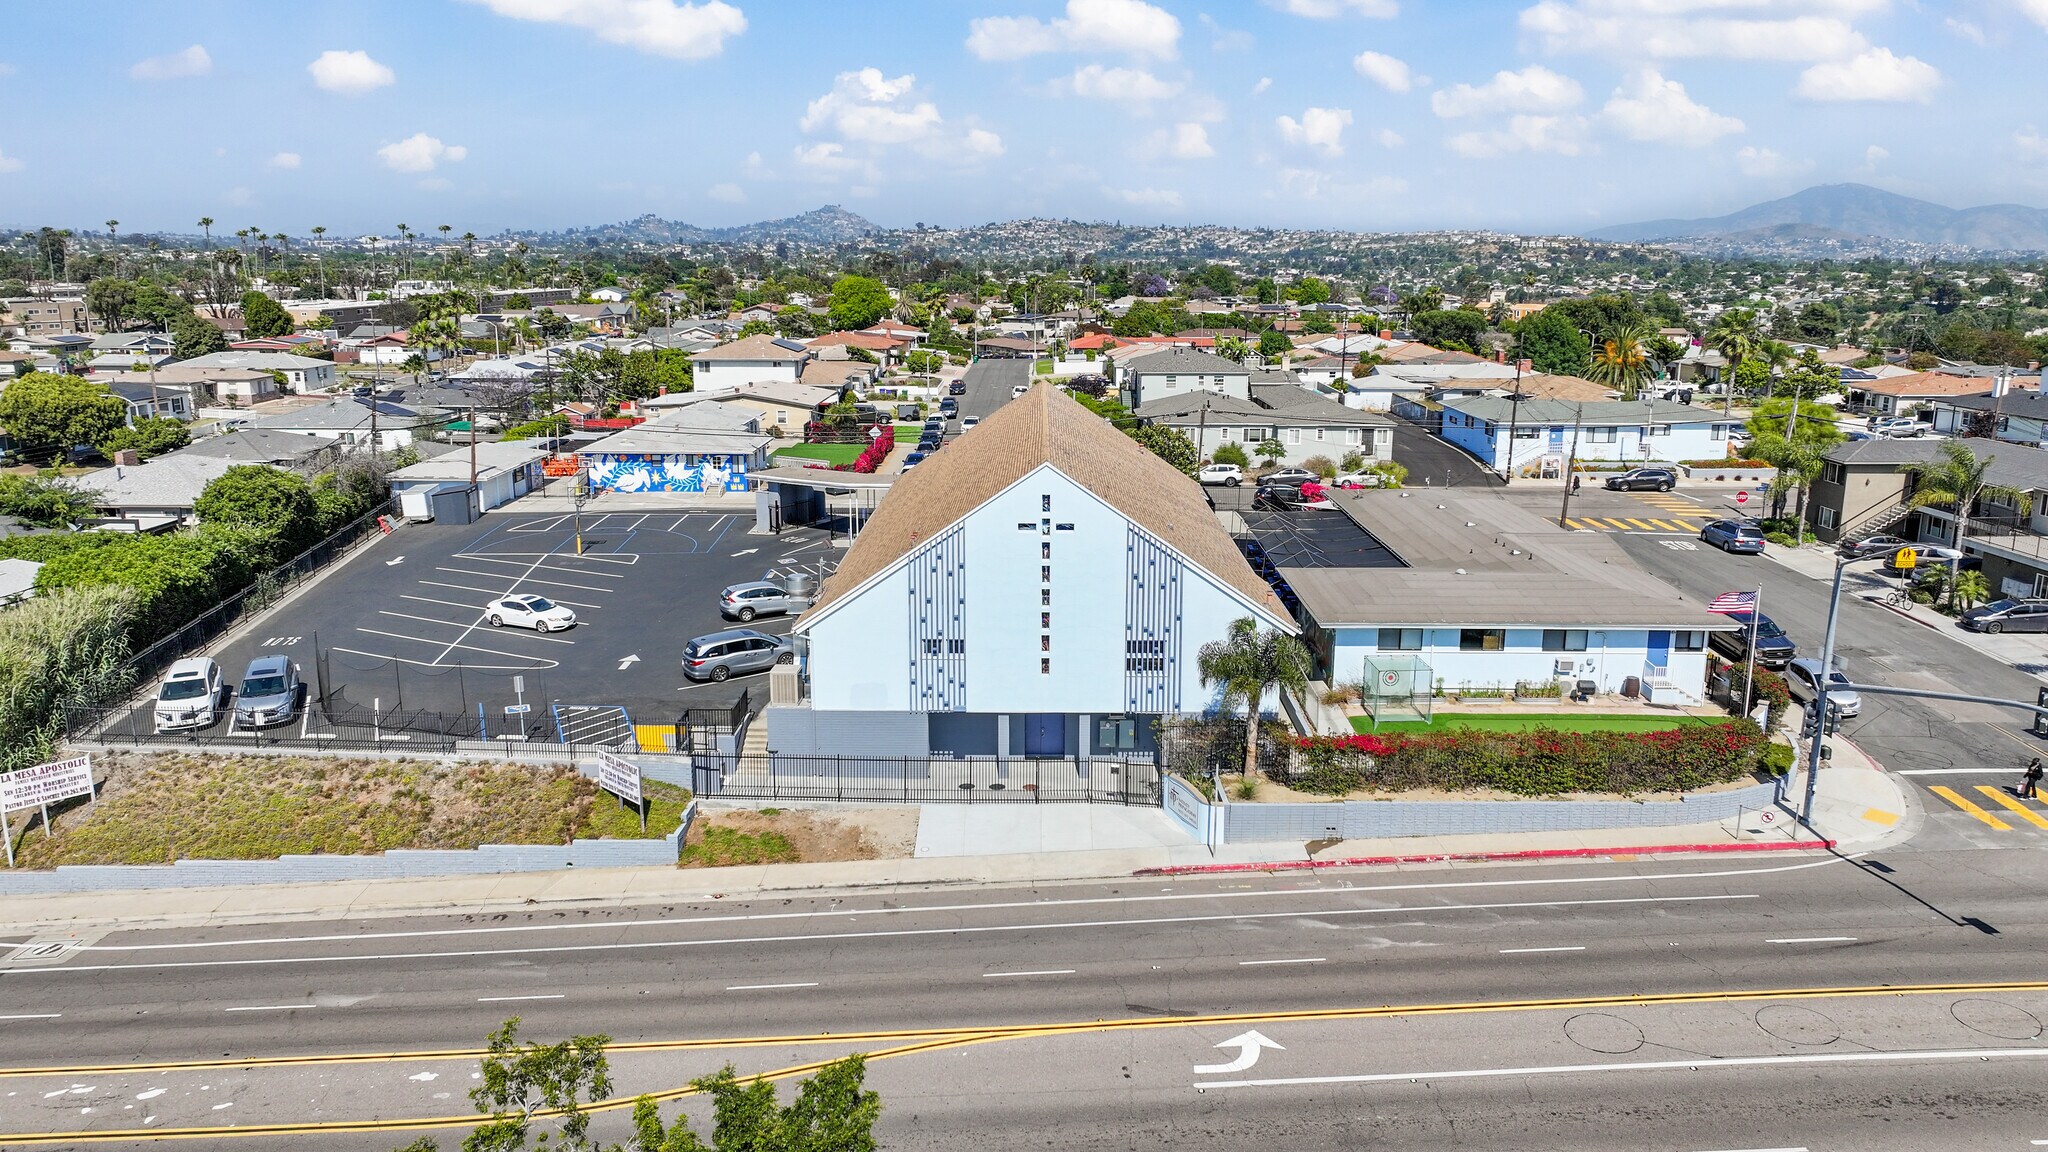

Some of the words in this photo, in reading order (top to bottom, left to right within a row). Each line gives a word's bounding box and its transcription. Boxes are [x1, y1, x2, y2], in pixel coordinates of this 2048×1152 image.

[0, 774, 11, 783] LA
[14, 769, 37, 781] MESA
[40, 758, 87, 775] APOSTOLIC
[15, 785, 32, 795] 12:30
